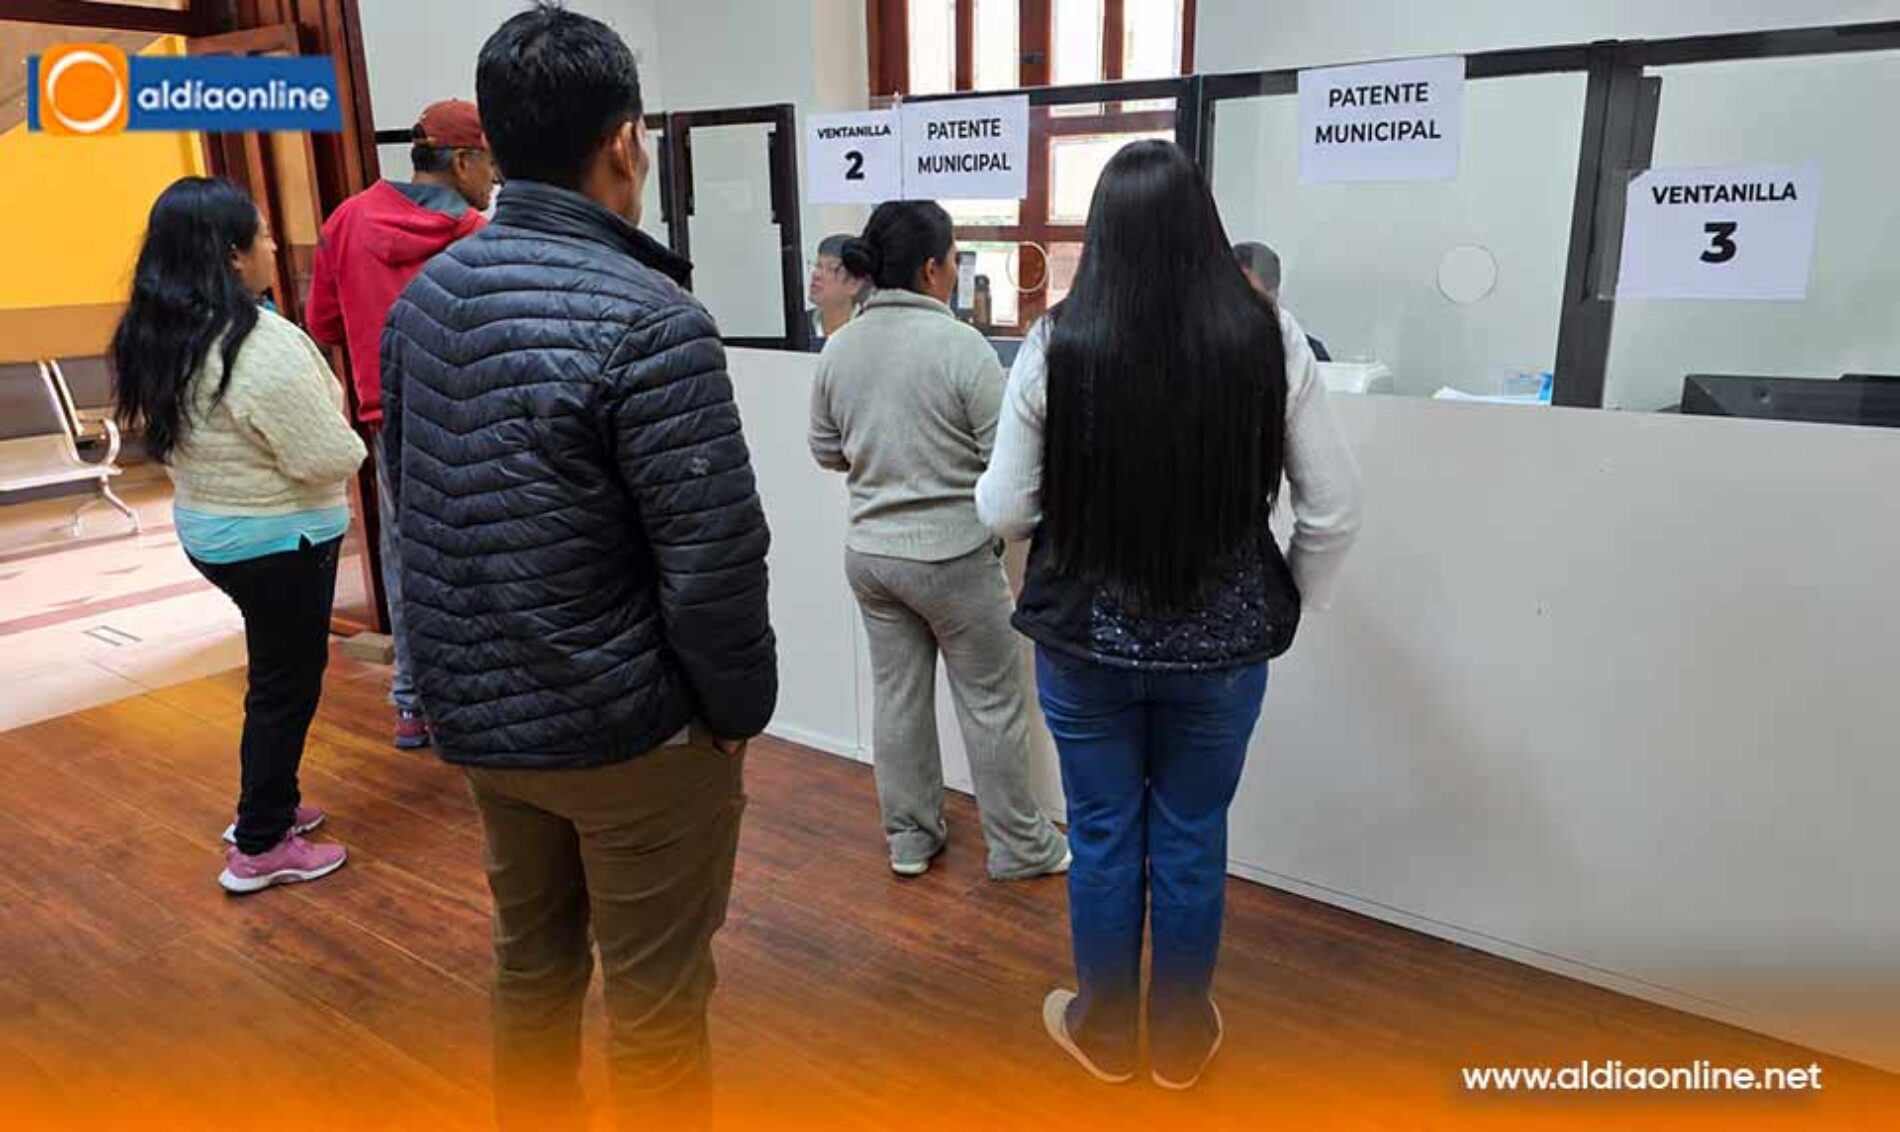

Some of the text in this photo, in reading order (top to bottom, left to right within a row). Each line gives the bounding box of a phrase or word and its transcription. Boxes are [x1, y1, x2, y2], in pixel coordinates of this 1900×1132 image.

[1328, 82, 1429, 108] PATENTE
[817, 124, 892, 140] VENTANILLA
[927, 118, 1001, 140] PATENTE
[1314, 118, 1442, 145] MUNICIPAL
[844, 150, 865, 181] 2
[917, 152, 1012, 175] MUNICIPAL
[1651, 181, 1798, 205] VENTANILLA
[1699, 220, 1738, 264] 3
